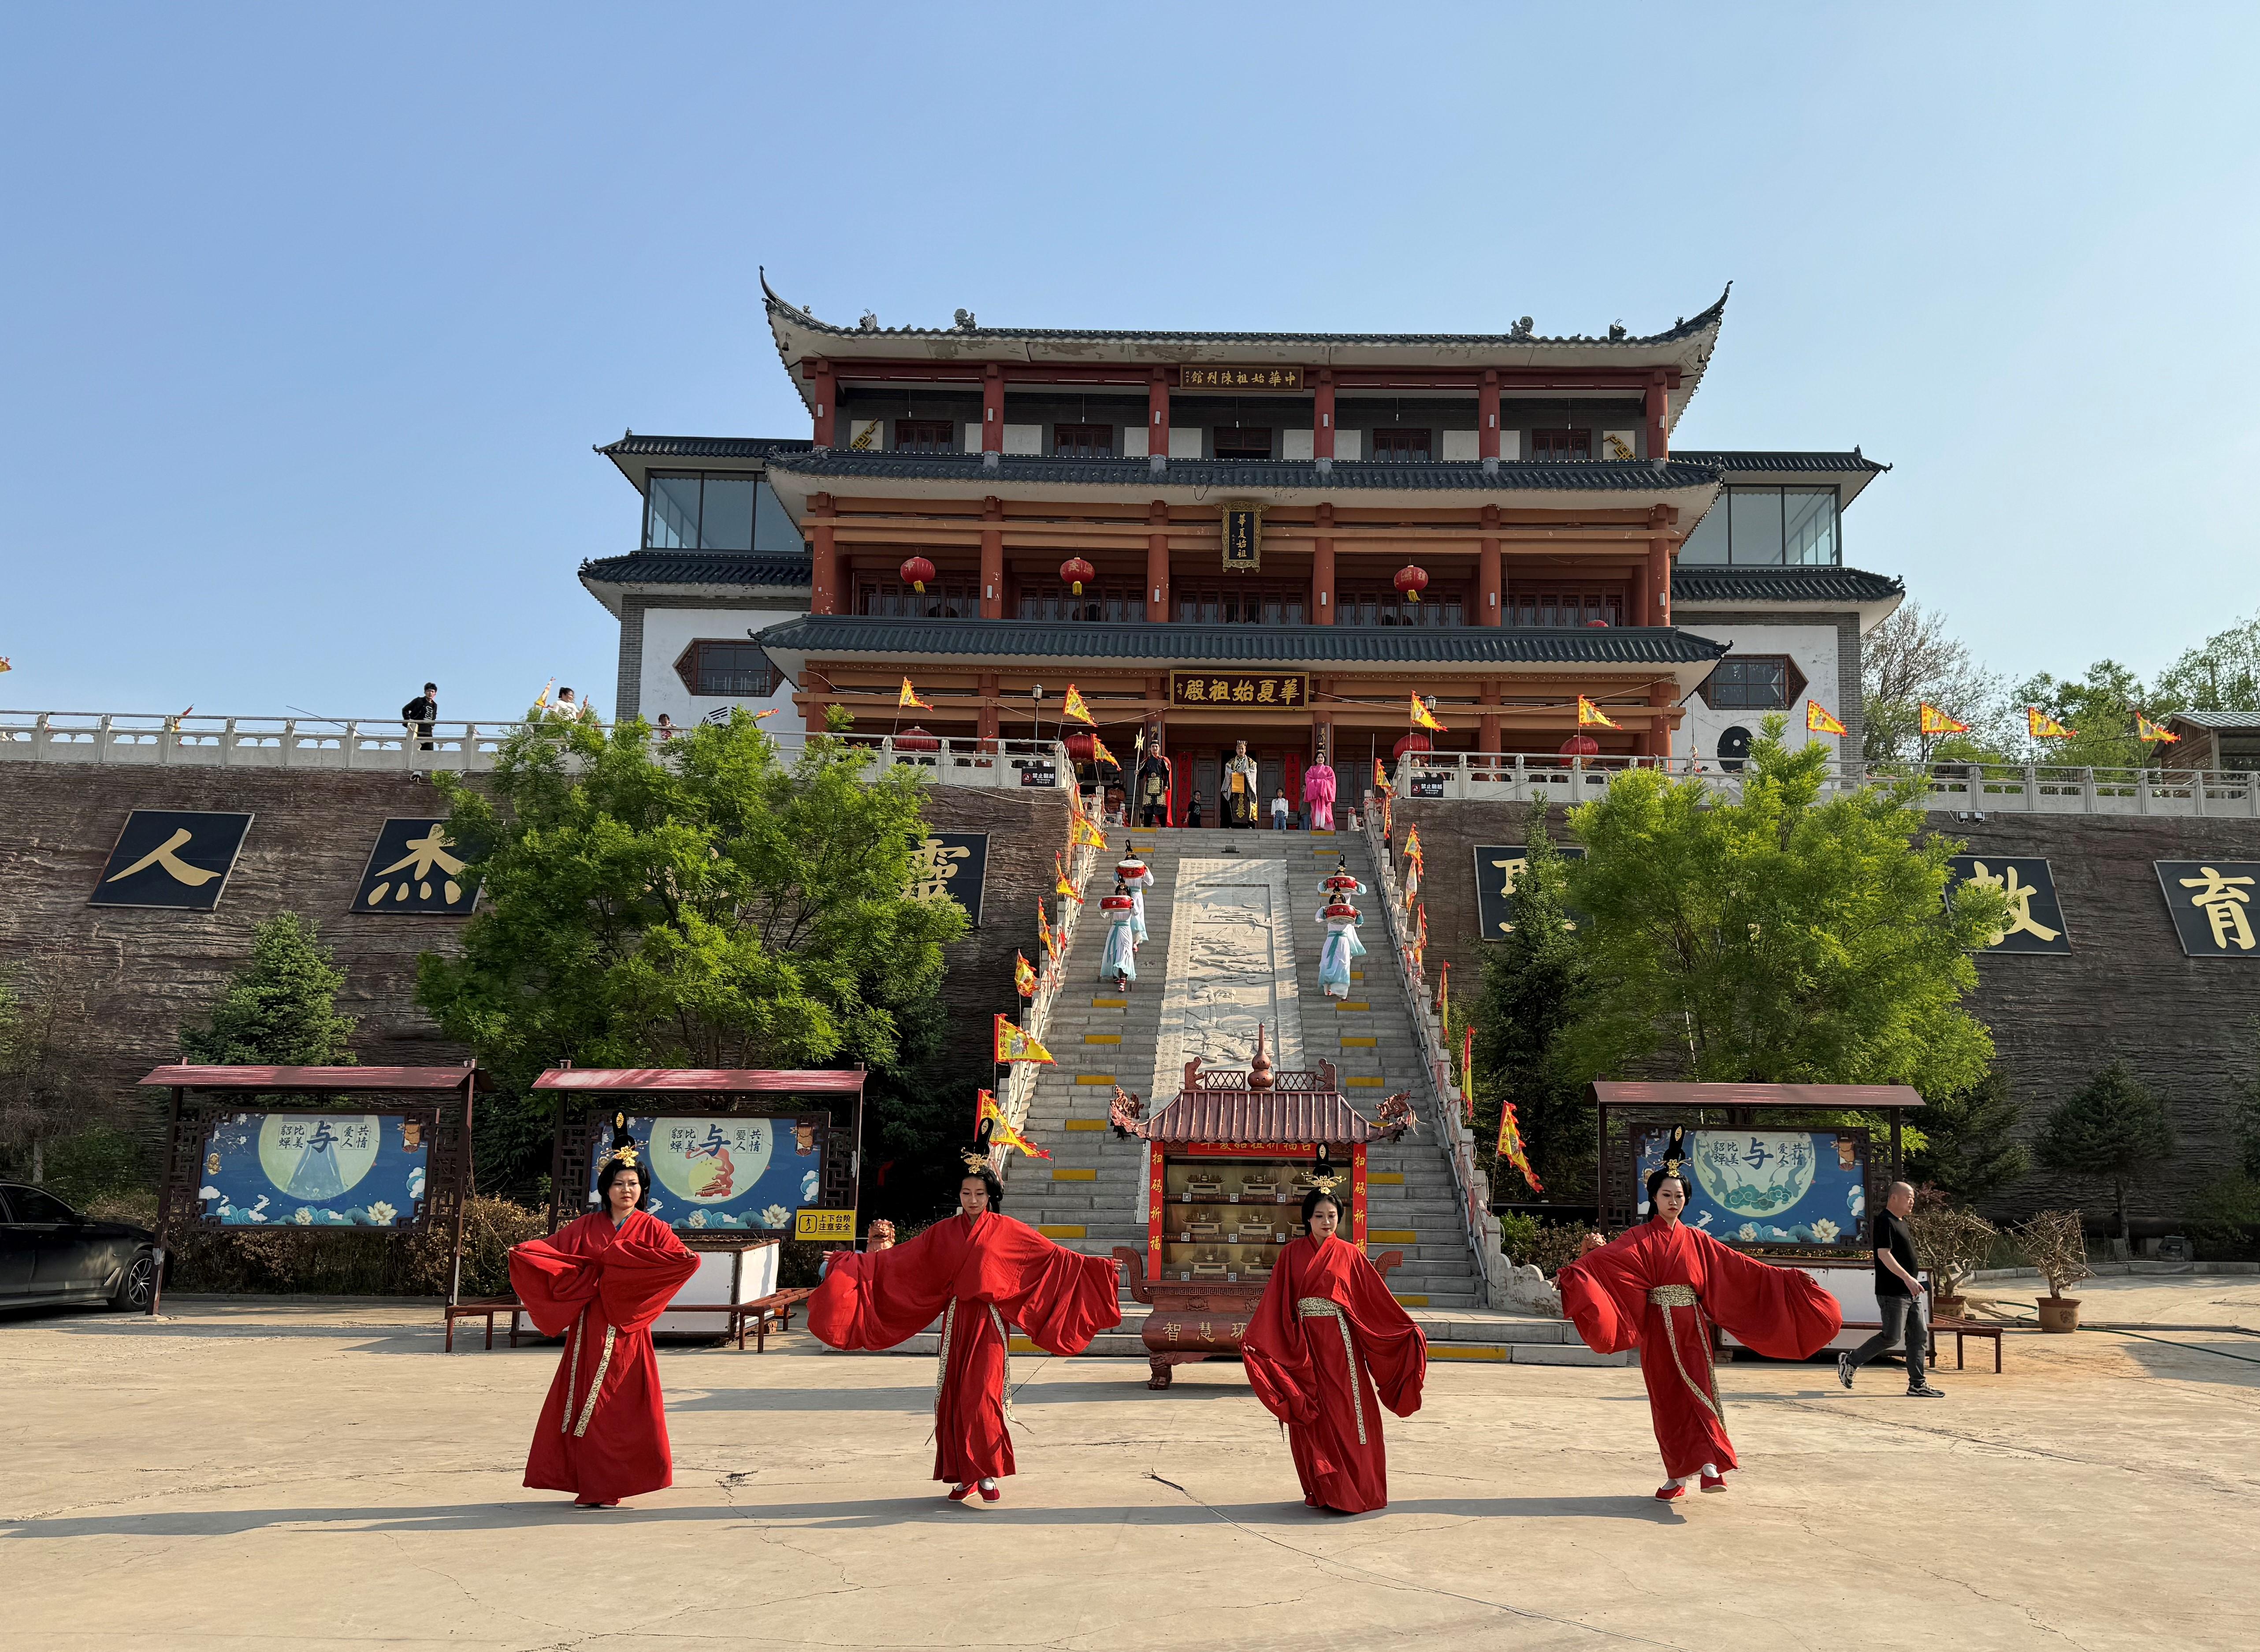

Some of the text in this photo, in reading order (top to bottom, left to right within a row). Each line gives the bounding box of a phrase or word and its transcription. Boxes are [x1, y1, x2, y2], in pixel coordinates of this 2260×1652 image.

[1191, 370, 1296, 387] 中華始祖陳列館
[1236, 513, 1247, 558] 華夏始祖
[1184, 678, 1300, 705] 華夏始祖殿
[107, 828, 222, 886] 人
[368, 823, 465, 906] 杰
[2179, 867, 2256, 949] 育
[307, 1120, 338, 1153] 与
[698, 1124, 731, 1157] 与
[1741, 1137, 1774, 1170] 与
[1149, 1150, 1162, 1251] 扫码祈福
[819, 1222, 851, 1231] 注意安全
[1162, 1321, 1247, 1343] 智慧环
